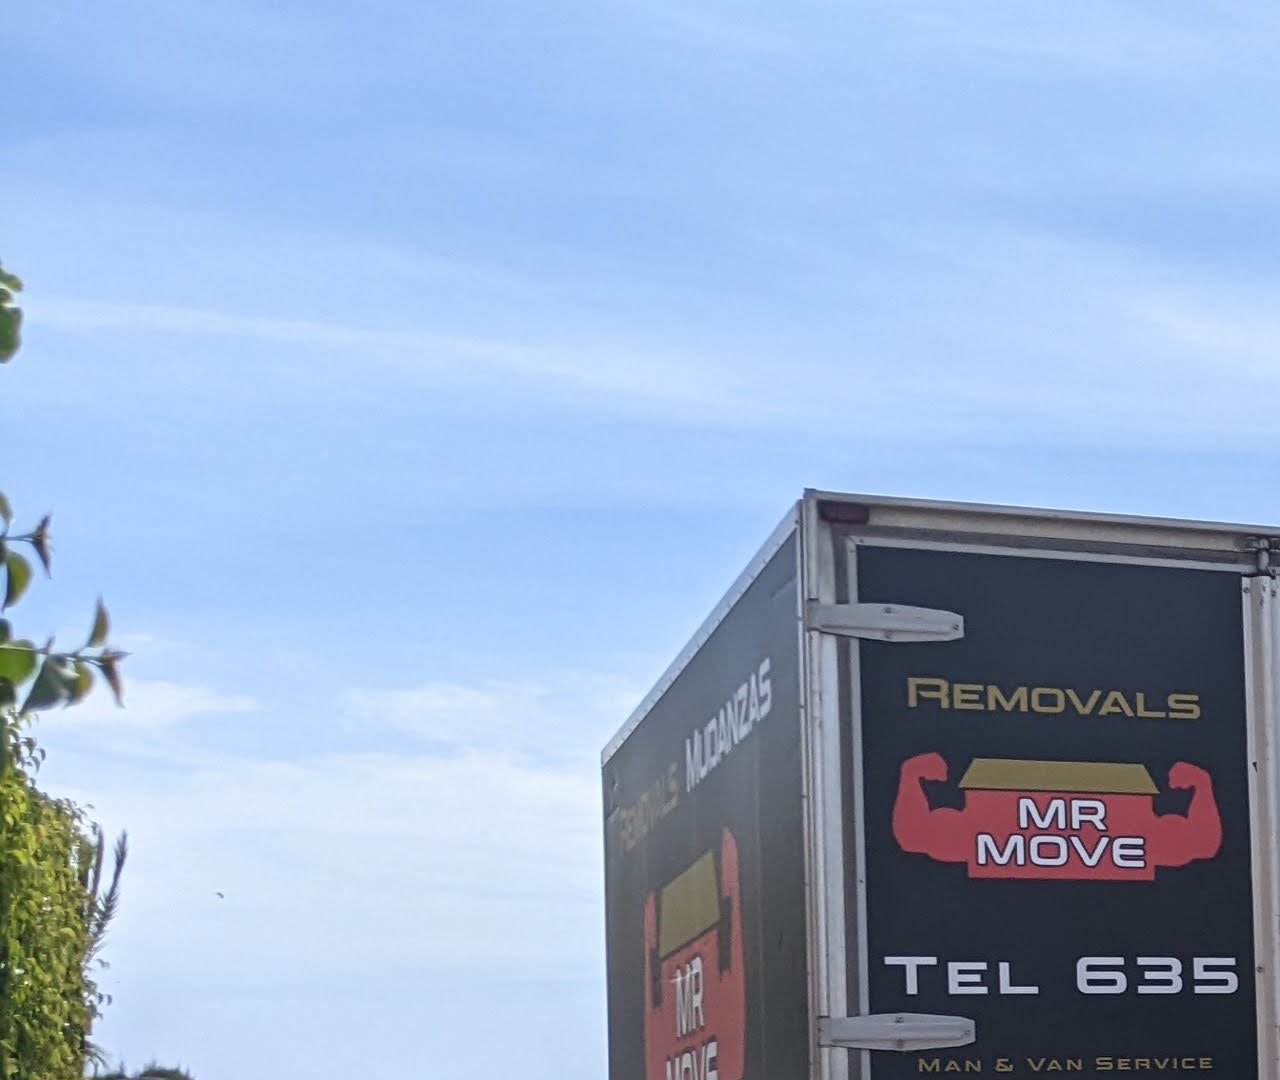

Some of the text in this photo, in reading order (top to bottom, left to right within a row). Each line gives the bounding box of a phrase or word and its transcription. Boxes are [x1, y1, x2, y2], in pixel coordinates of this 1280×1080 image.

[908, 677, 1202, 720] REMOVALS
[685, 656, 771, 792] MUDANZAS
[1019, 798, 1107, 832] MR
[977, 834, 1147, 868] MOVE
[884, 956, 1039, 995] TEL
[1076, 957, 1239, 995] 635
[675, 956, 705, 1035] MR
[918, 1056, 1214, 1073] MAN & VAN SERVICE
